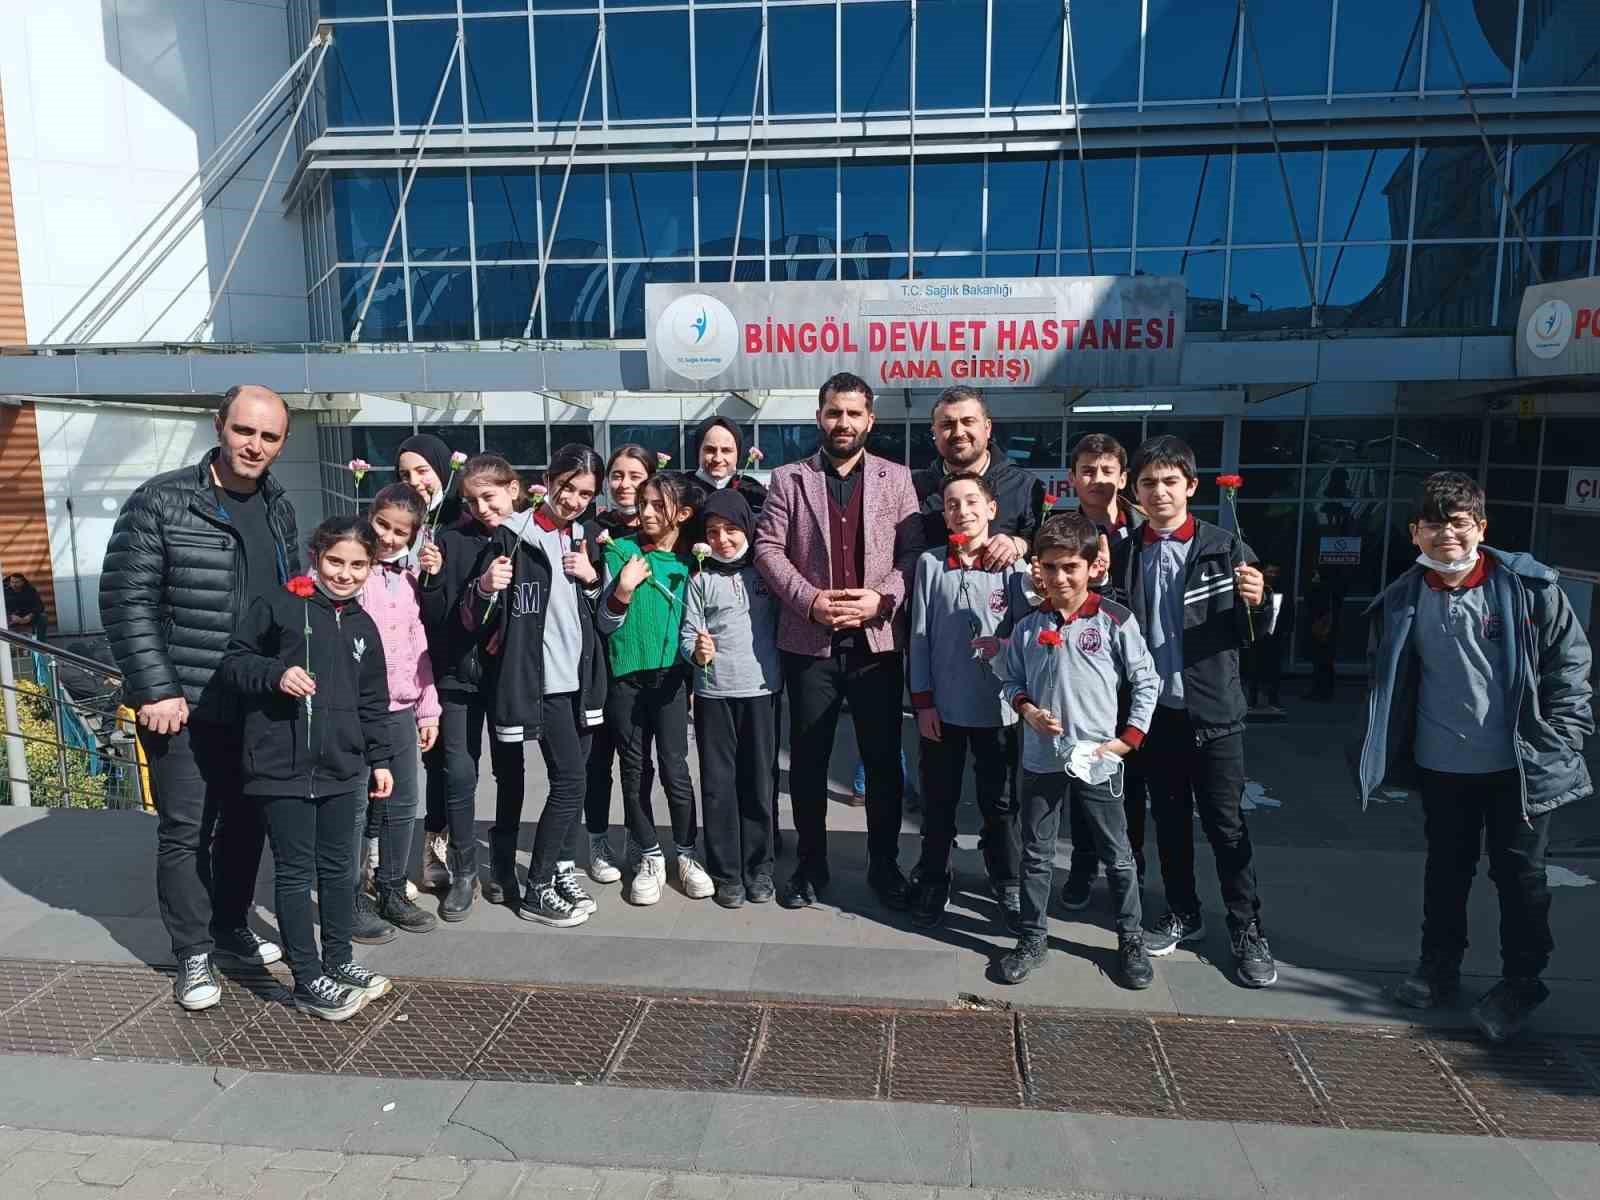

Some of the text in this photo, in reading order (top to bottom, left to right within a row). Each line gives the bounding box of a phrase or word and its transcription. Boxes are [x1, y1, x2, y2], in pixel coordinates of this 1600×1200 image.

[902, 284, 1012, 298] T.C. Sağlık Bakanlığı
[745, 311, 1175, 353] BİNGÖL DEVLET HASTANESİ
[880, 354, 1032, 384] (ANA GİRİŞ)
